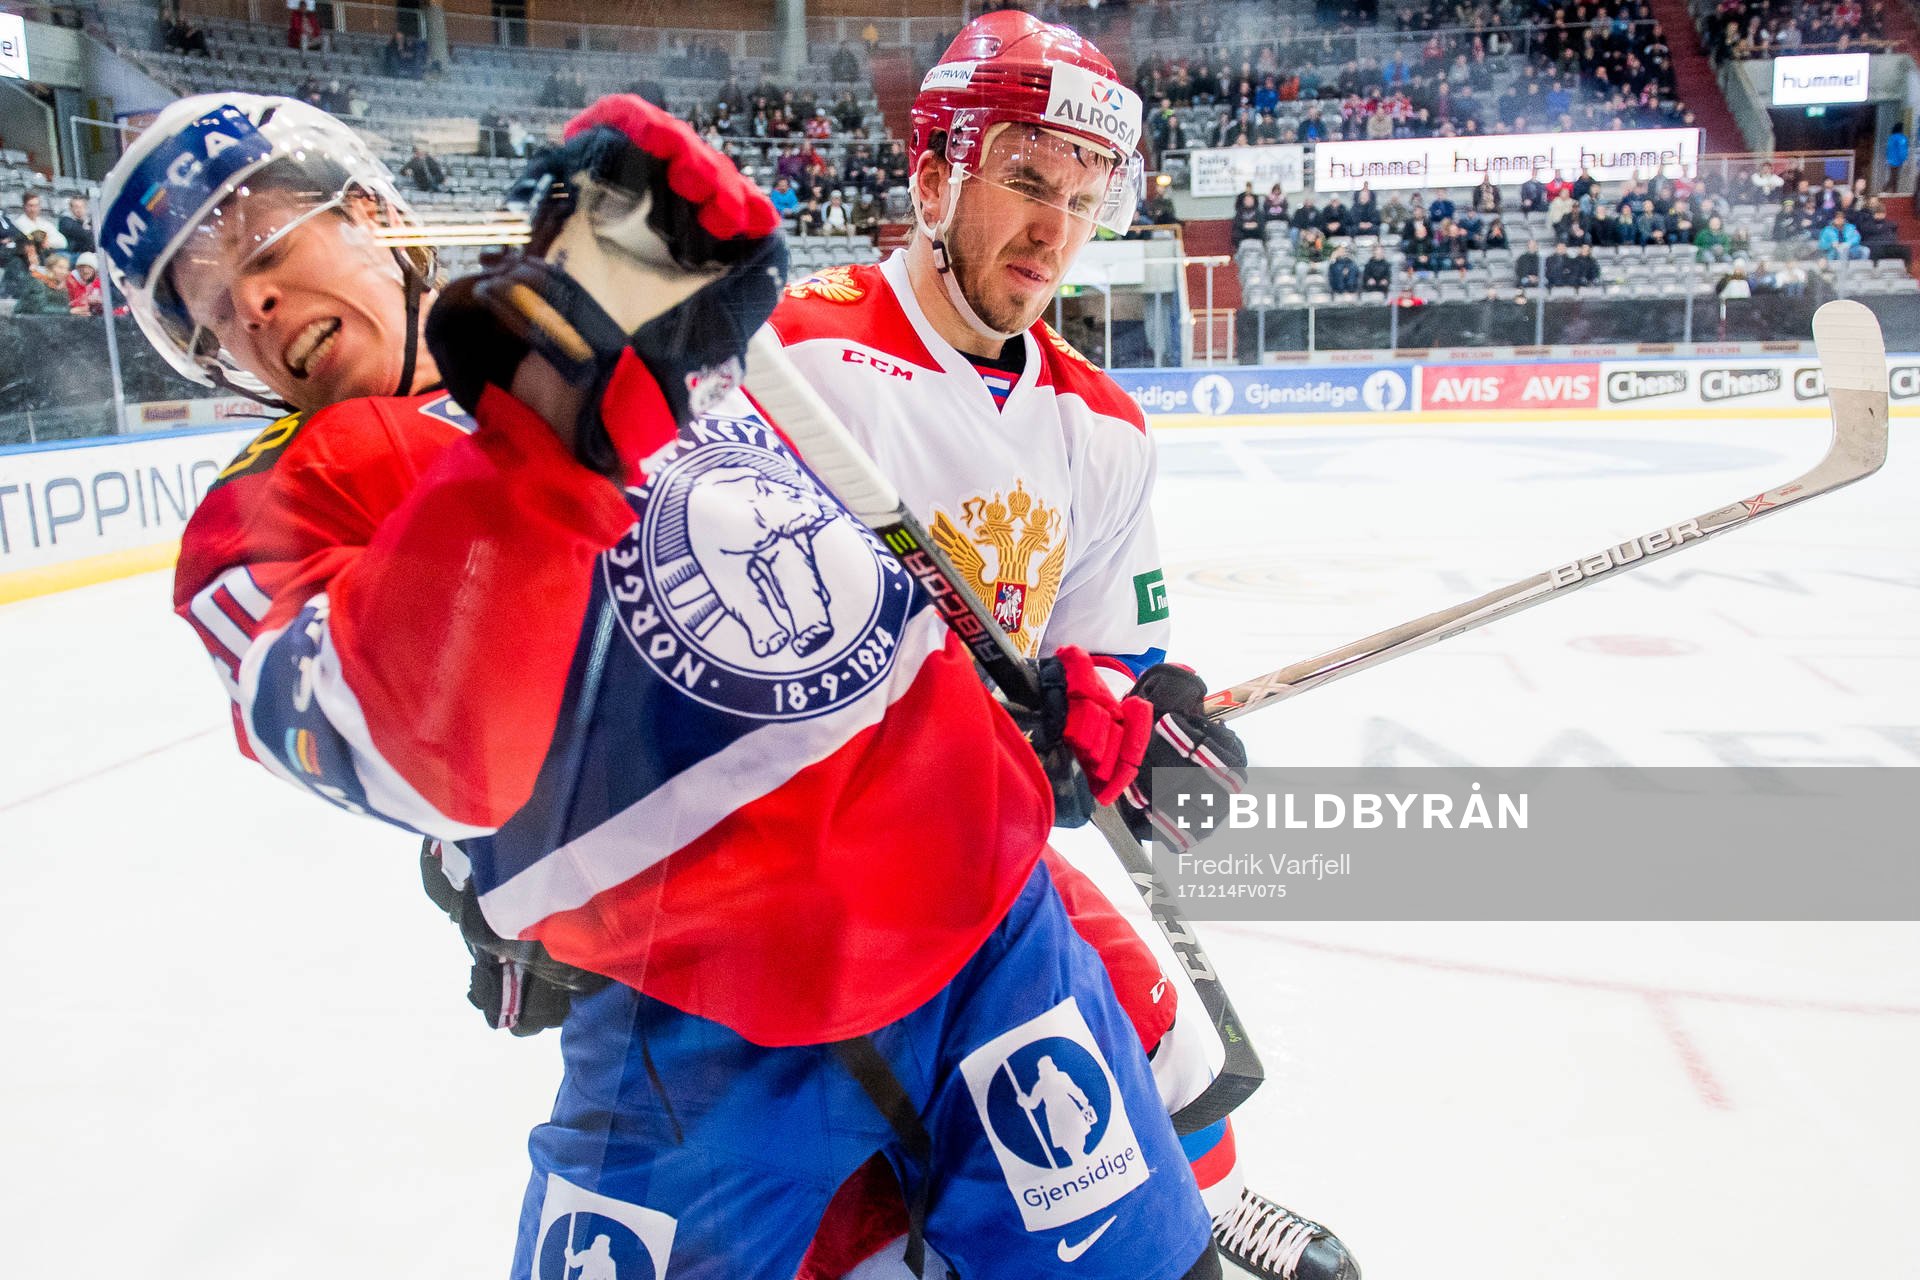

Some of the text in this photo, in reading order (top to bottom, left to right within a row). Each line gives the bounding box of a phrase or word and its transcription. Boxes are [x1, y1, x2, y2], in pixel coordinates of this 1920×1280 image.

[1783, 69, 1861, 89] hummel
[1053, 98, 1136, 147] ALROSA
[1330, 141, 1684, 179] hummel hummel hummel
[842, 348, 913, 382] CCM
[1244, 381, 1359, 409] Gjensidige
[1430, 375, 1592, 403] AVIS AVIS
[1608, 371, 1685, 401] Chess
[1700, 370, 1780, 399] Chess
[1552, 517, 1705, 590] BAUER
[608, 521, 706, 689] NORGE
[773, 625, 896, 713] 18-9-1934
[1022, 1146, 1136, 1212] Gjensidige
